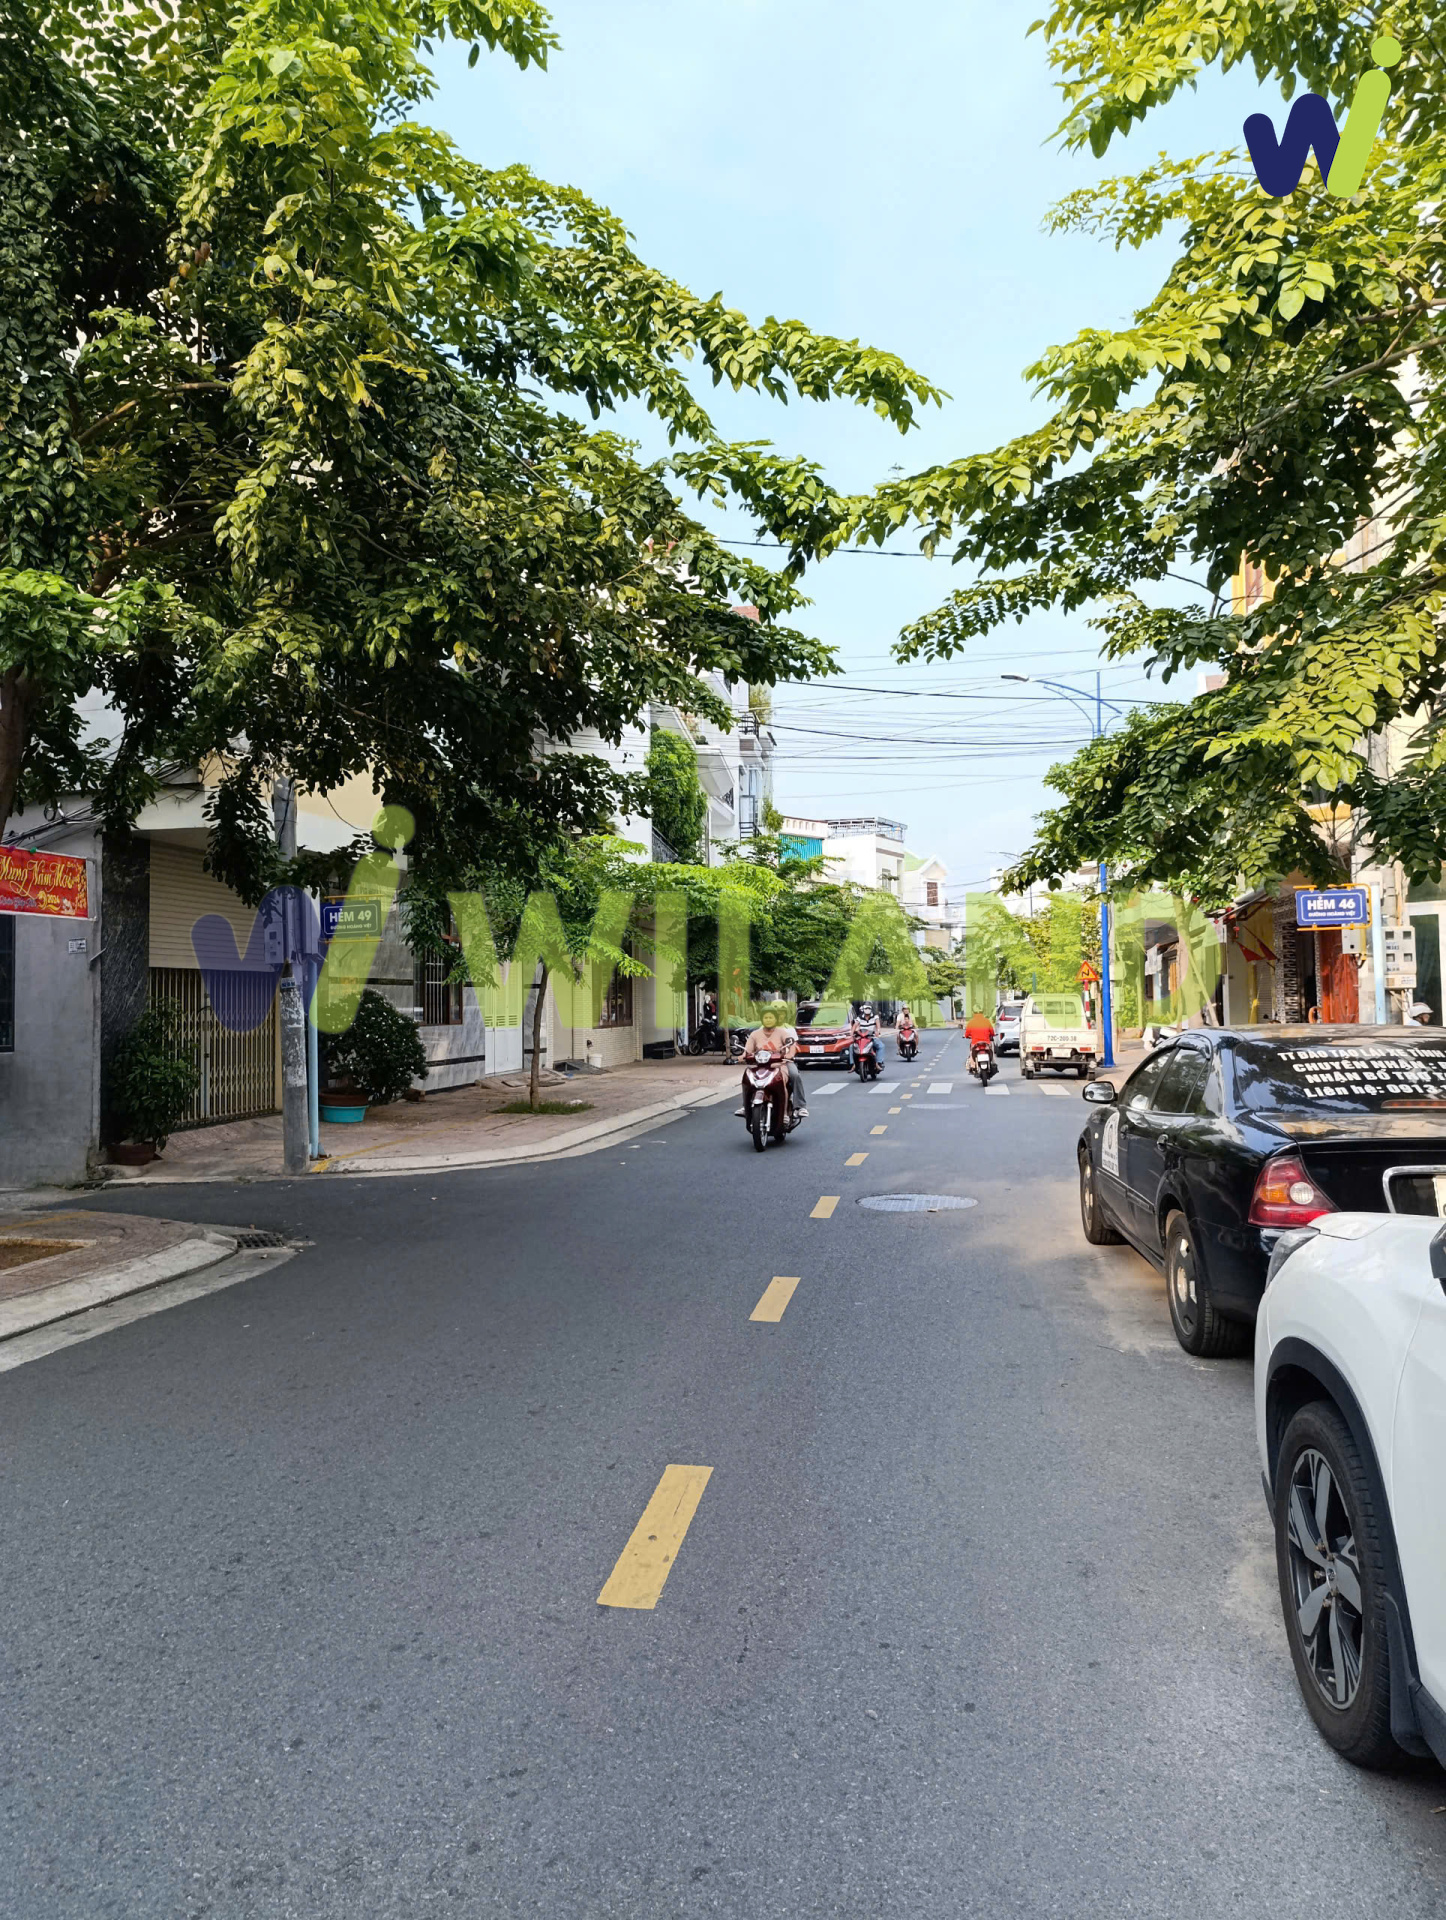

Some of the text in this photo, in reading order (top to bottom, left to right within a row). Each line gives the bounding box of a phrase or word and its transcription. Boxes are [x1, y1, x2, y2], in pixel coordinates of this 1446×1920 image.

[1307, 896, 1356, 910] HẺM 46
[330, 908, 372, 923] HẺM 49
[1277, 1052, 1295, 1061] TT
[1328, 1049, 1359, 1059] TẠO
[1386, 1048, 1408, 1057] XE
[1292, 1060, 1370, 1073] CHUYÊN
[1305, 1071, 1362, 1084] NHẬN
[1349, 1084, 1385, 1096] hệ:
